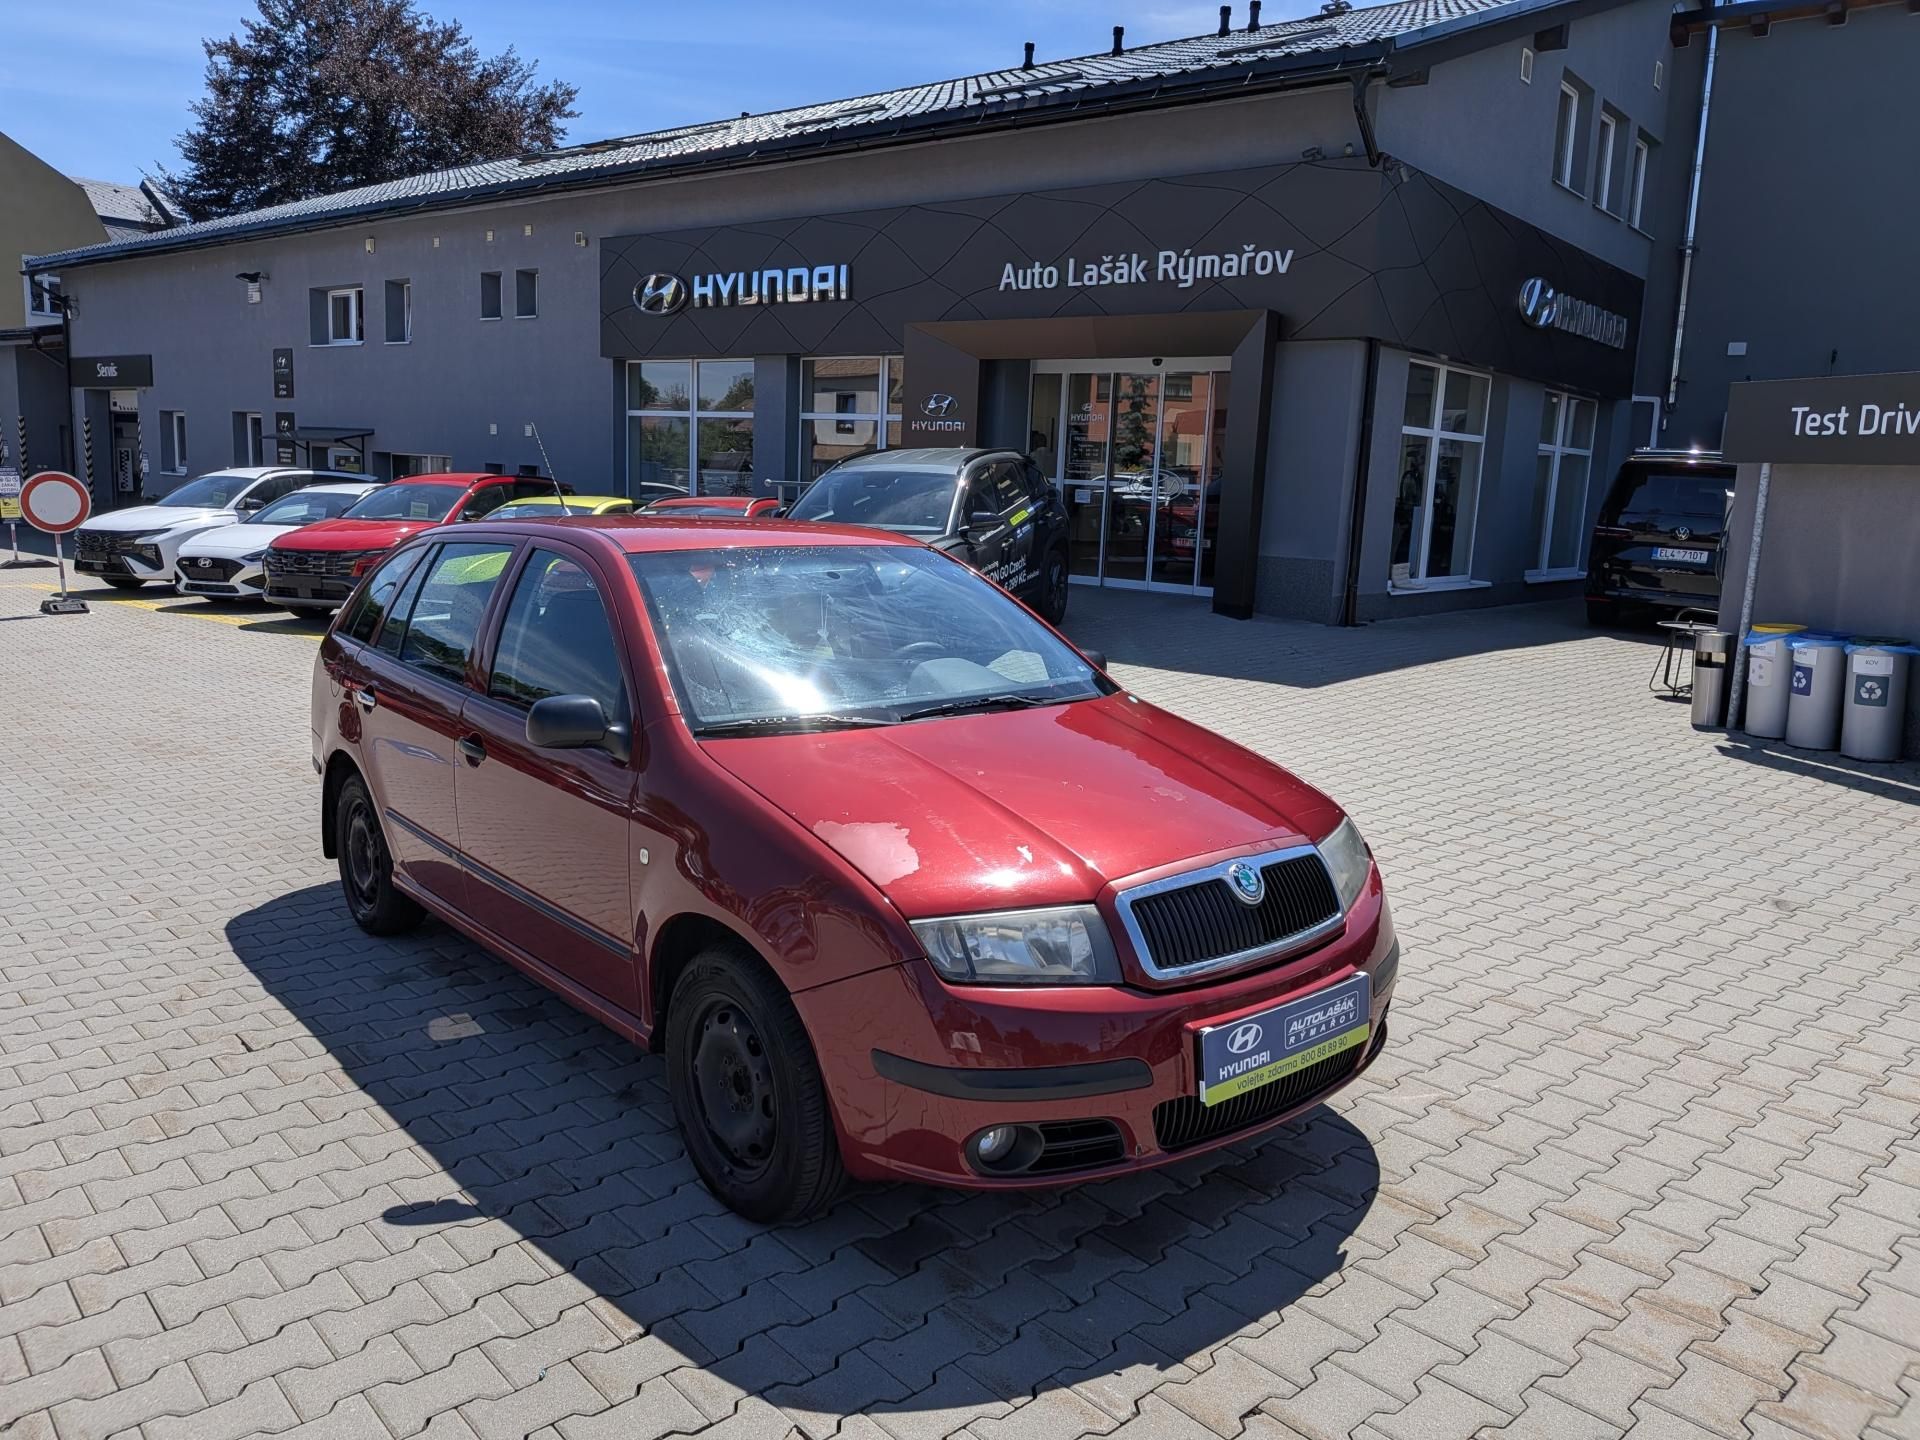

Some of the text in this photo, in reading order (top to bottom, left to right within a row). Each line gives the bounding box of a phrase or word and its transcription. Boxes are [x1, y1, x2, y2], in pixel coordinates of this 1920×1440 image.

[999, 244, 1295, 291] Auto Lašák Rýmařov
[693, 264, 848, 308] HYUNDAI
[96, 362, 118, 377] Servis
[911, 420, 966, 432] HYUNDAI
[1070, 413, 1105, 422] HYUNDAI
[1791, 406, 1849, 436] Test
[1288, 997, 1355, 1033] AUTOLAŠÁK
[1288, 1011, 1355, 1046] RÝMAŘOV
[1219, 1050, 1271, 1081] HYUNDAI
[1236, 1036, 1348, 1090] volejte zdarma 800 88 89 90
